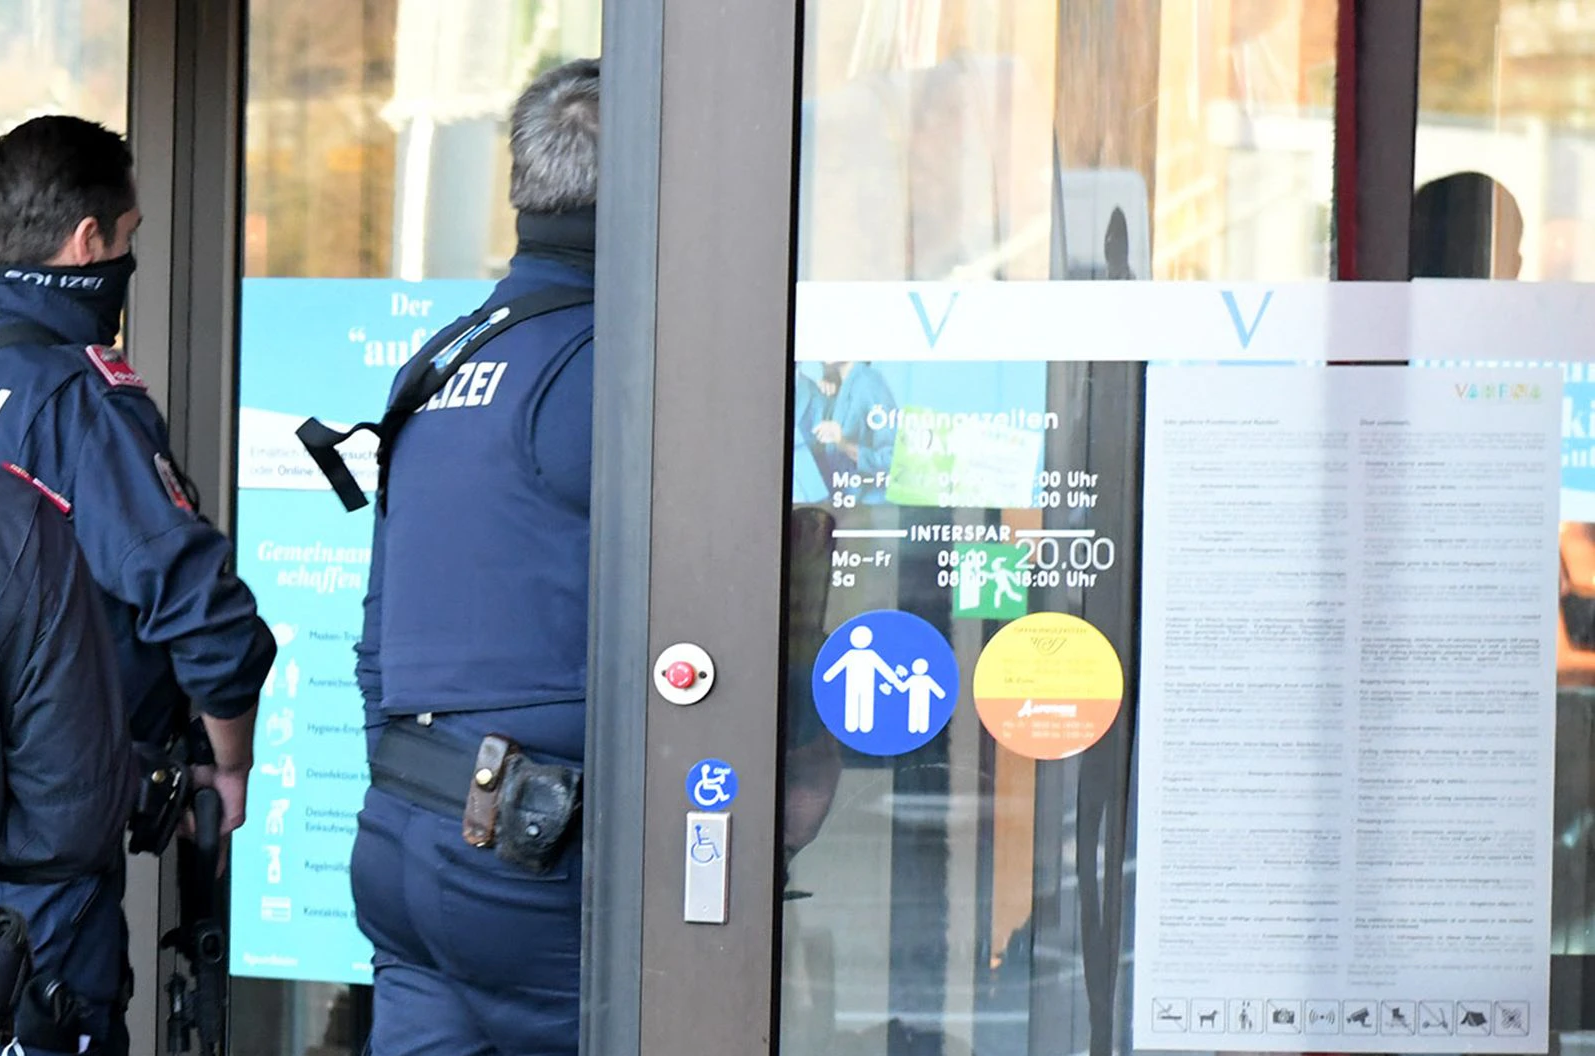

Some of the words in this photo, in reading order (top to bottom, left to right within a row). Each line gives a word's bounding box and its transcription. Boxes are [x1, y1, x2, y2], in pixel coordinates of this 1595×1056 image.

[391, 292, 433, 317] Der
[1067, 471, 1098, 487] Uhr
[832, 492, 856, 508] Sa
[1067, 491, 1098, 507] Uhr
[910, 525, 1011, 542] INTERSPAR
[1014, 537, 1115, 570] 20.00
[277, 564, 363, 593] schaffen
[832, 571, 856, 587] Sa
[1066, 571, 1098, 587] Uhr
